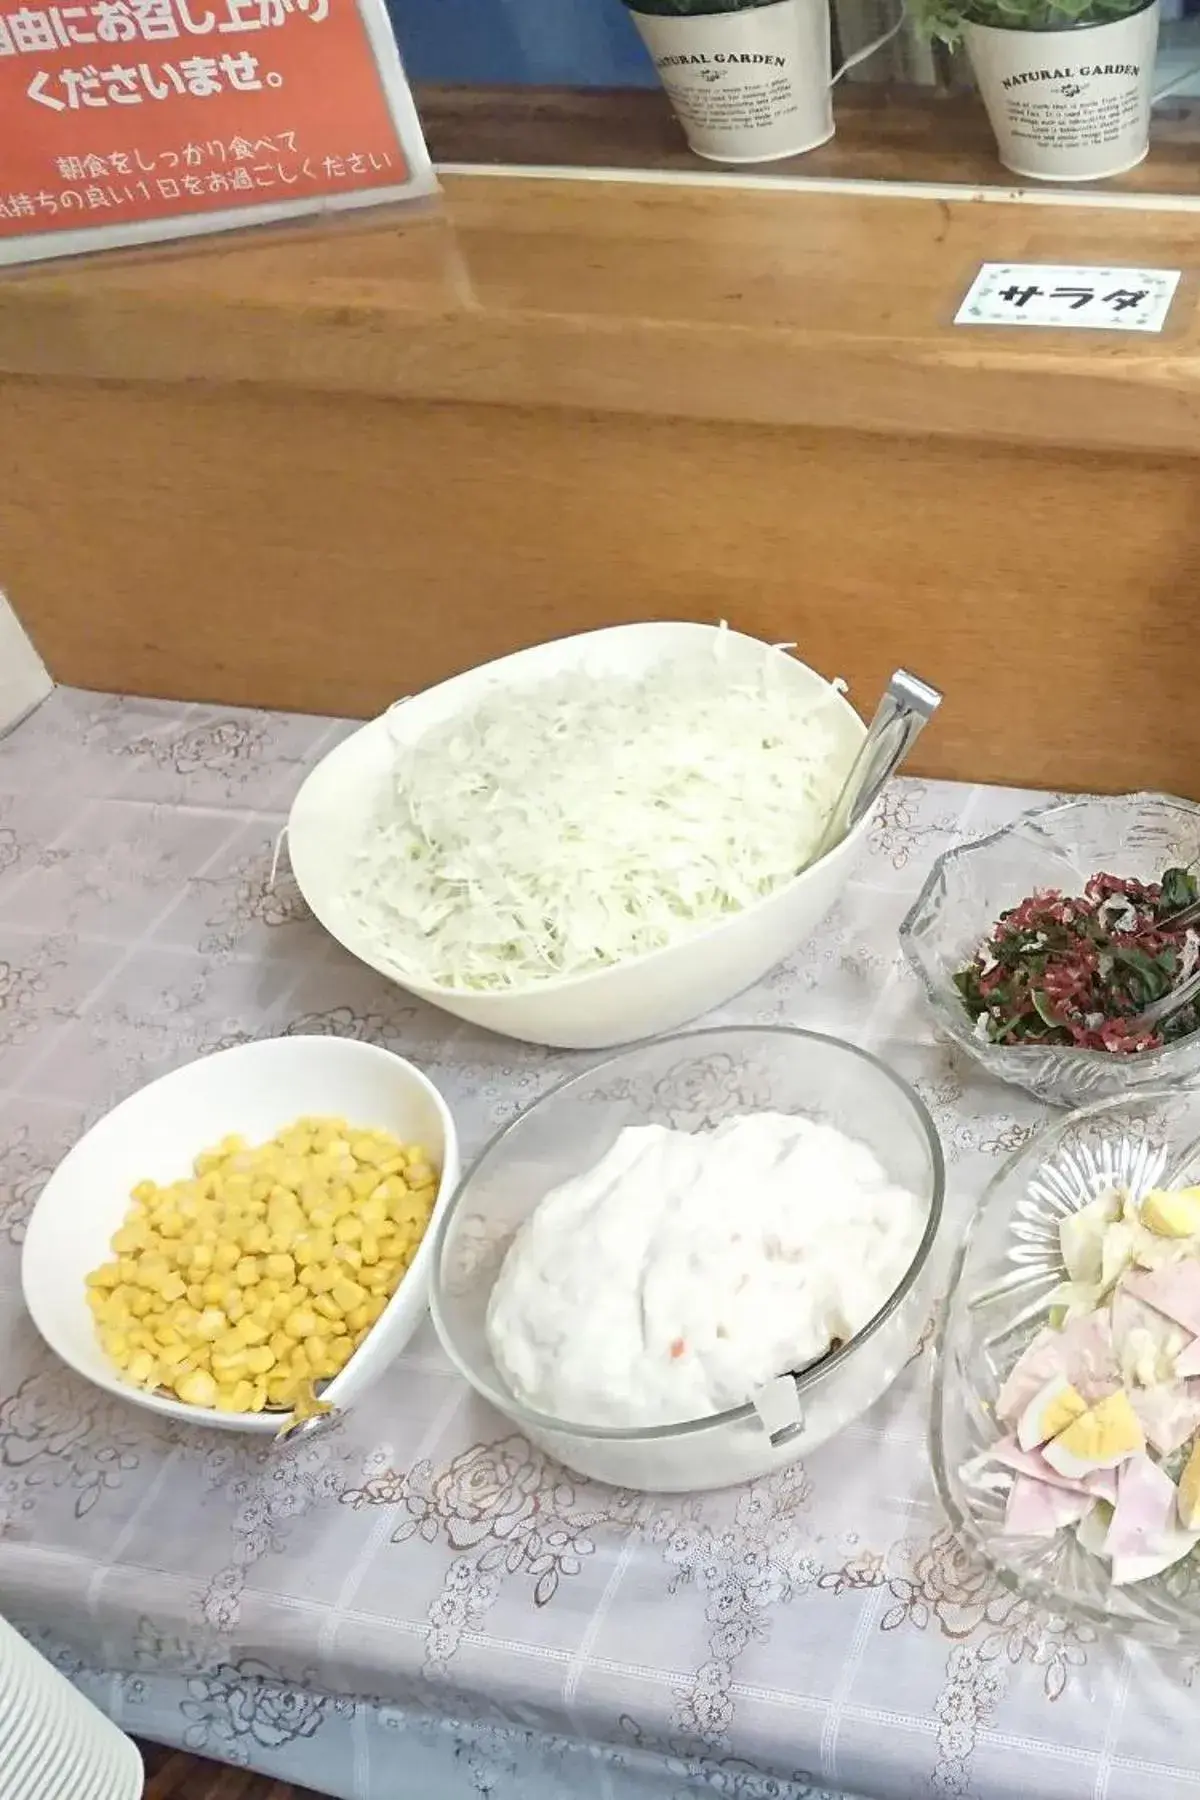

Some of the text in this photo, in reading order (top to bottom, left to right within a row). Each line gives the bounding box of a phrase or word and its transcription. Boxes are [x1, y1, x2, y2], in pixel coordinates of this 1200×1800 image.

[0, 0, 330, 56] 由にお召し上がり
[714, 53, 786, 68] GARDEN
[1002, 64, 1140, 90] NATURAL GARDEN
[26, 51, 284, 112] くださいませ。
[56, 130, 298, 181] 朝食をしっかり食べて
[998, 285, 1150, 312] サラダ
